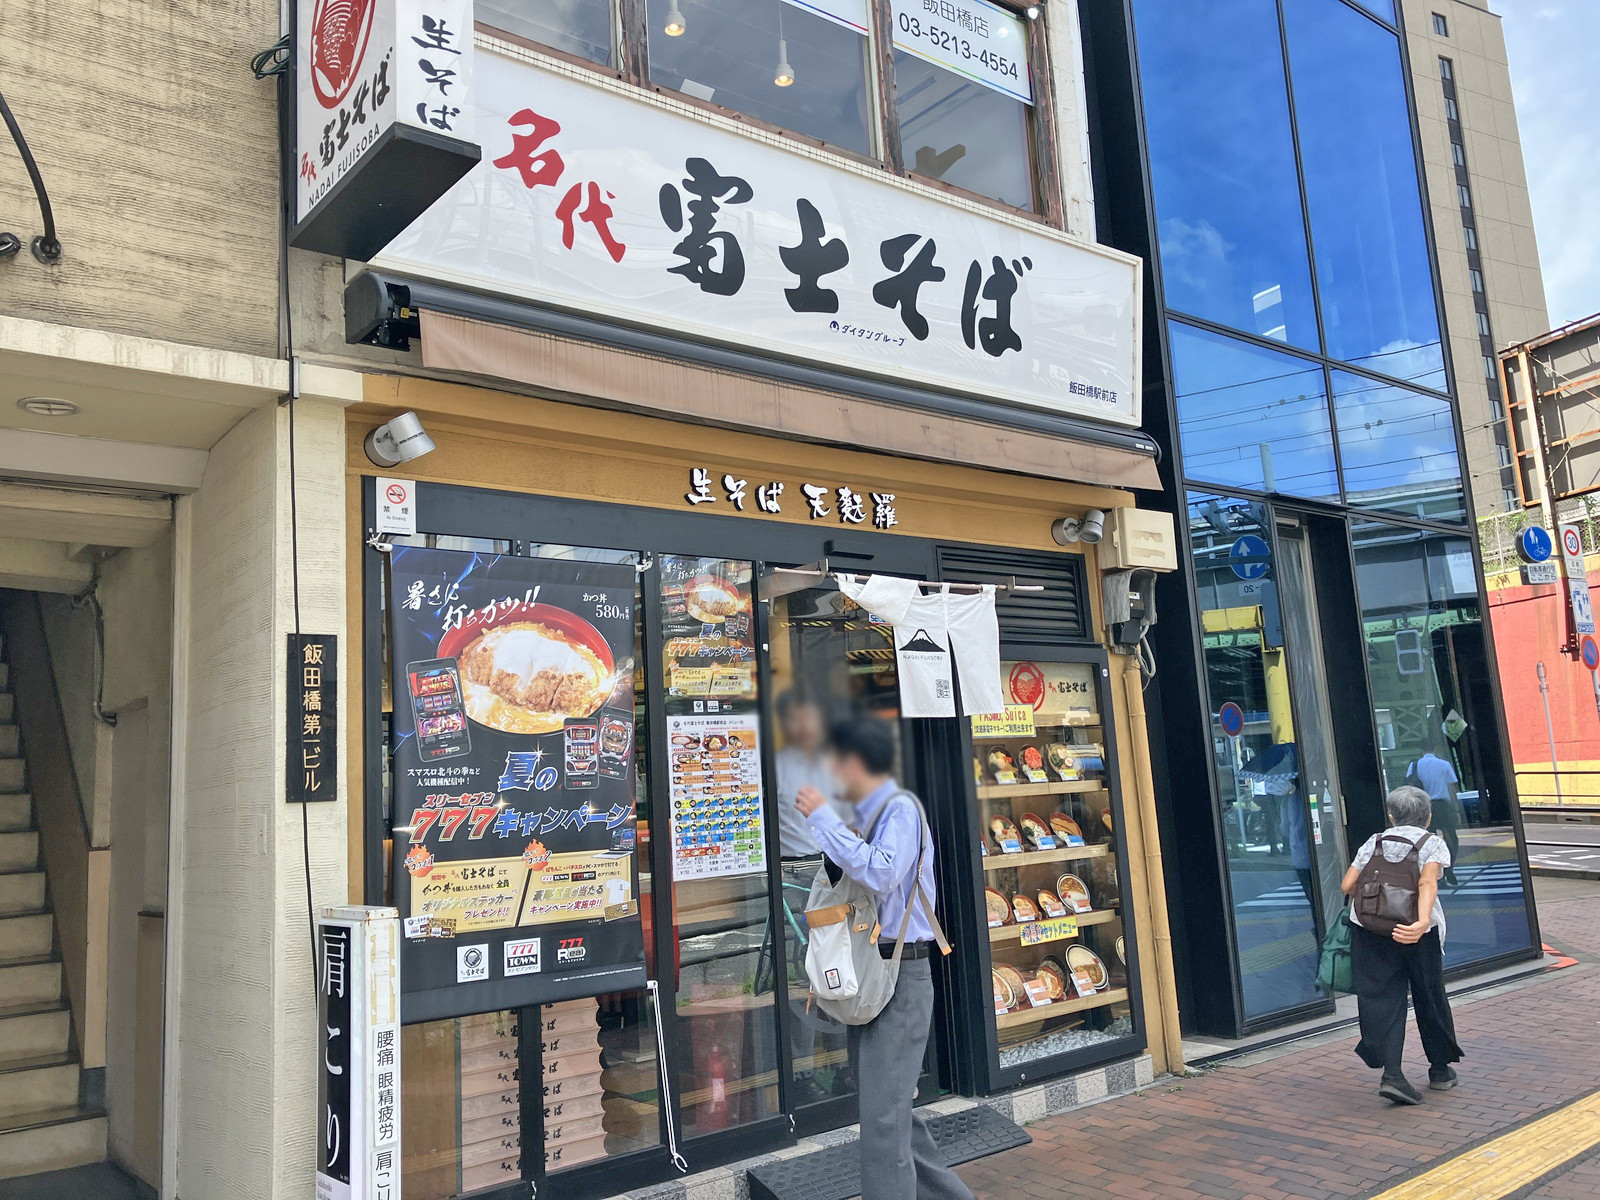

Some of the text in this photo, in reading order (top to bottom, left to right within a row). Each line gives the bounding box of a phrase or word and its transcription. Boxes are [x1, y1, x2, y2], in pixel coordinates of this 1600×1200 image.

[922, 0, 990, 39] 飯田橋店
[899, 12, 1019, 81] 03-5213-4554
[412, 14, 462, 132] 生そば
[318, 46, 394, 169] 富士そば
[307, 122, 381, 209] NADAI FUJISOBA
[492, 107, 1034, 358] 名代 富士そば
[841, 324, 907, 347] ダイタングループ
[1068, 380, 1118, 404] 飯田橋駅前店
[684, 467, 785, 514] 生そば
[383, 505, 409, 515] 禁煙
[1567, 536, 1577, 549] 30
[582, 592, 608, 604] かつ丼
[302, 642, 324, 793] 飯田橋第一ビル
[1004, 706, 1027, 721] Suica
[422, 792, 495, 808] スリーセブン
[511, 944, 534, 956] 777
[557, 946, 586, 960] Real
[559, 937, 584, 949] 777
[508, 955, 537, 967] TOWN
[320, 931, 348, 1169] 肩こり
[376, 1030, 395, 1142] 腰痛 眼精疲労
